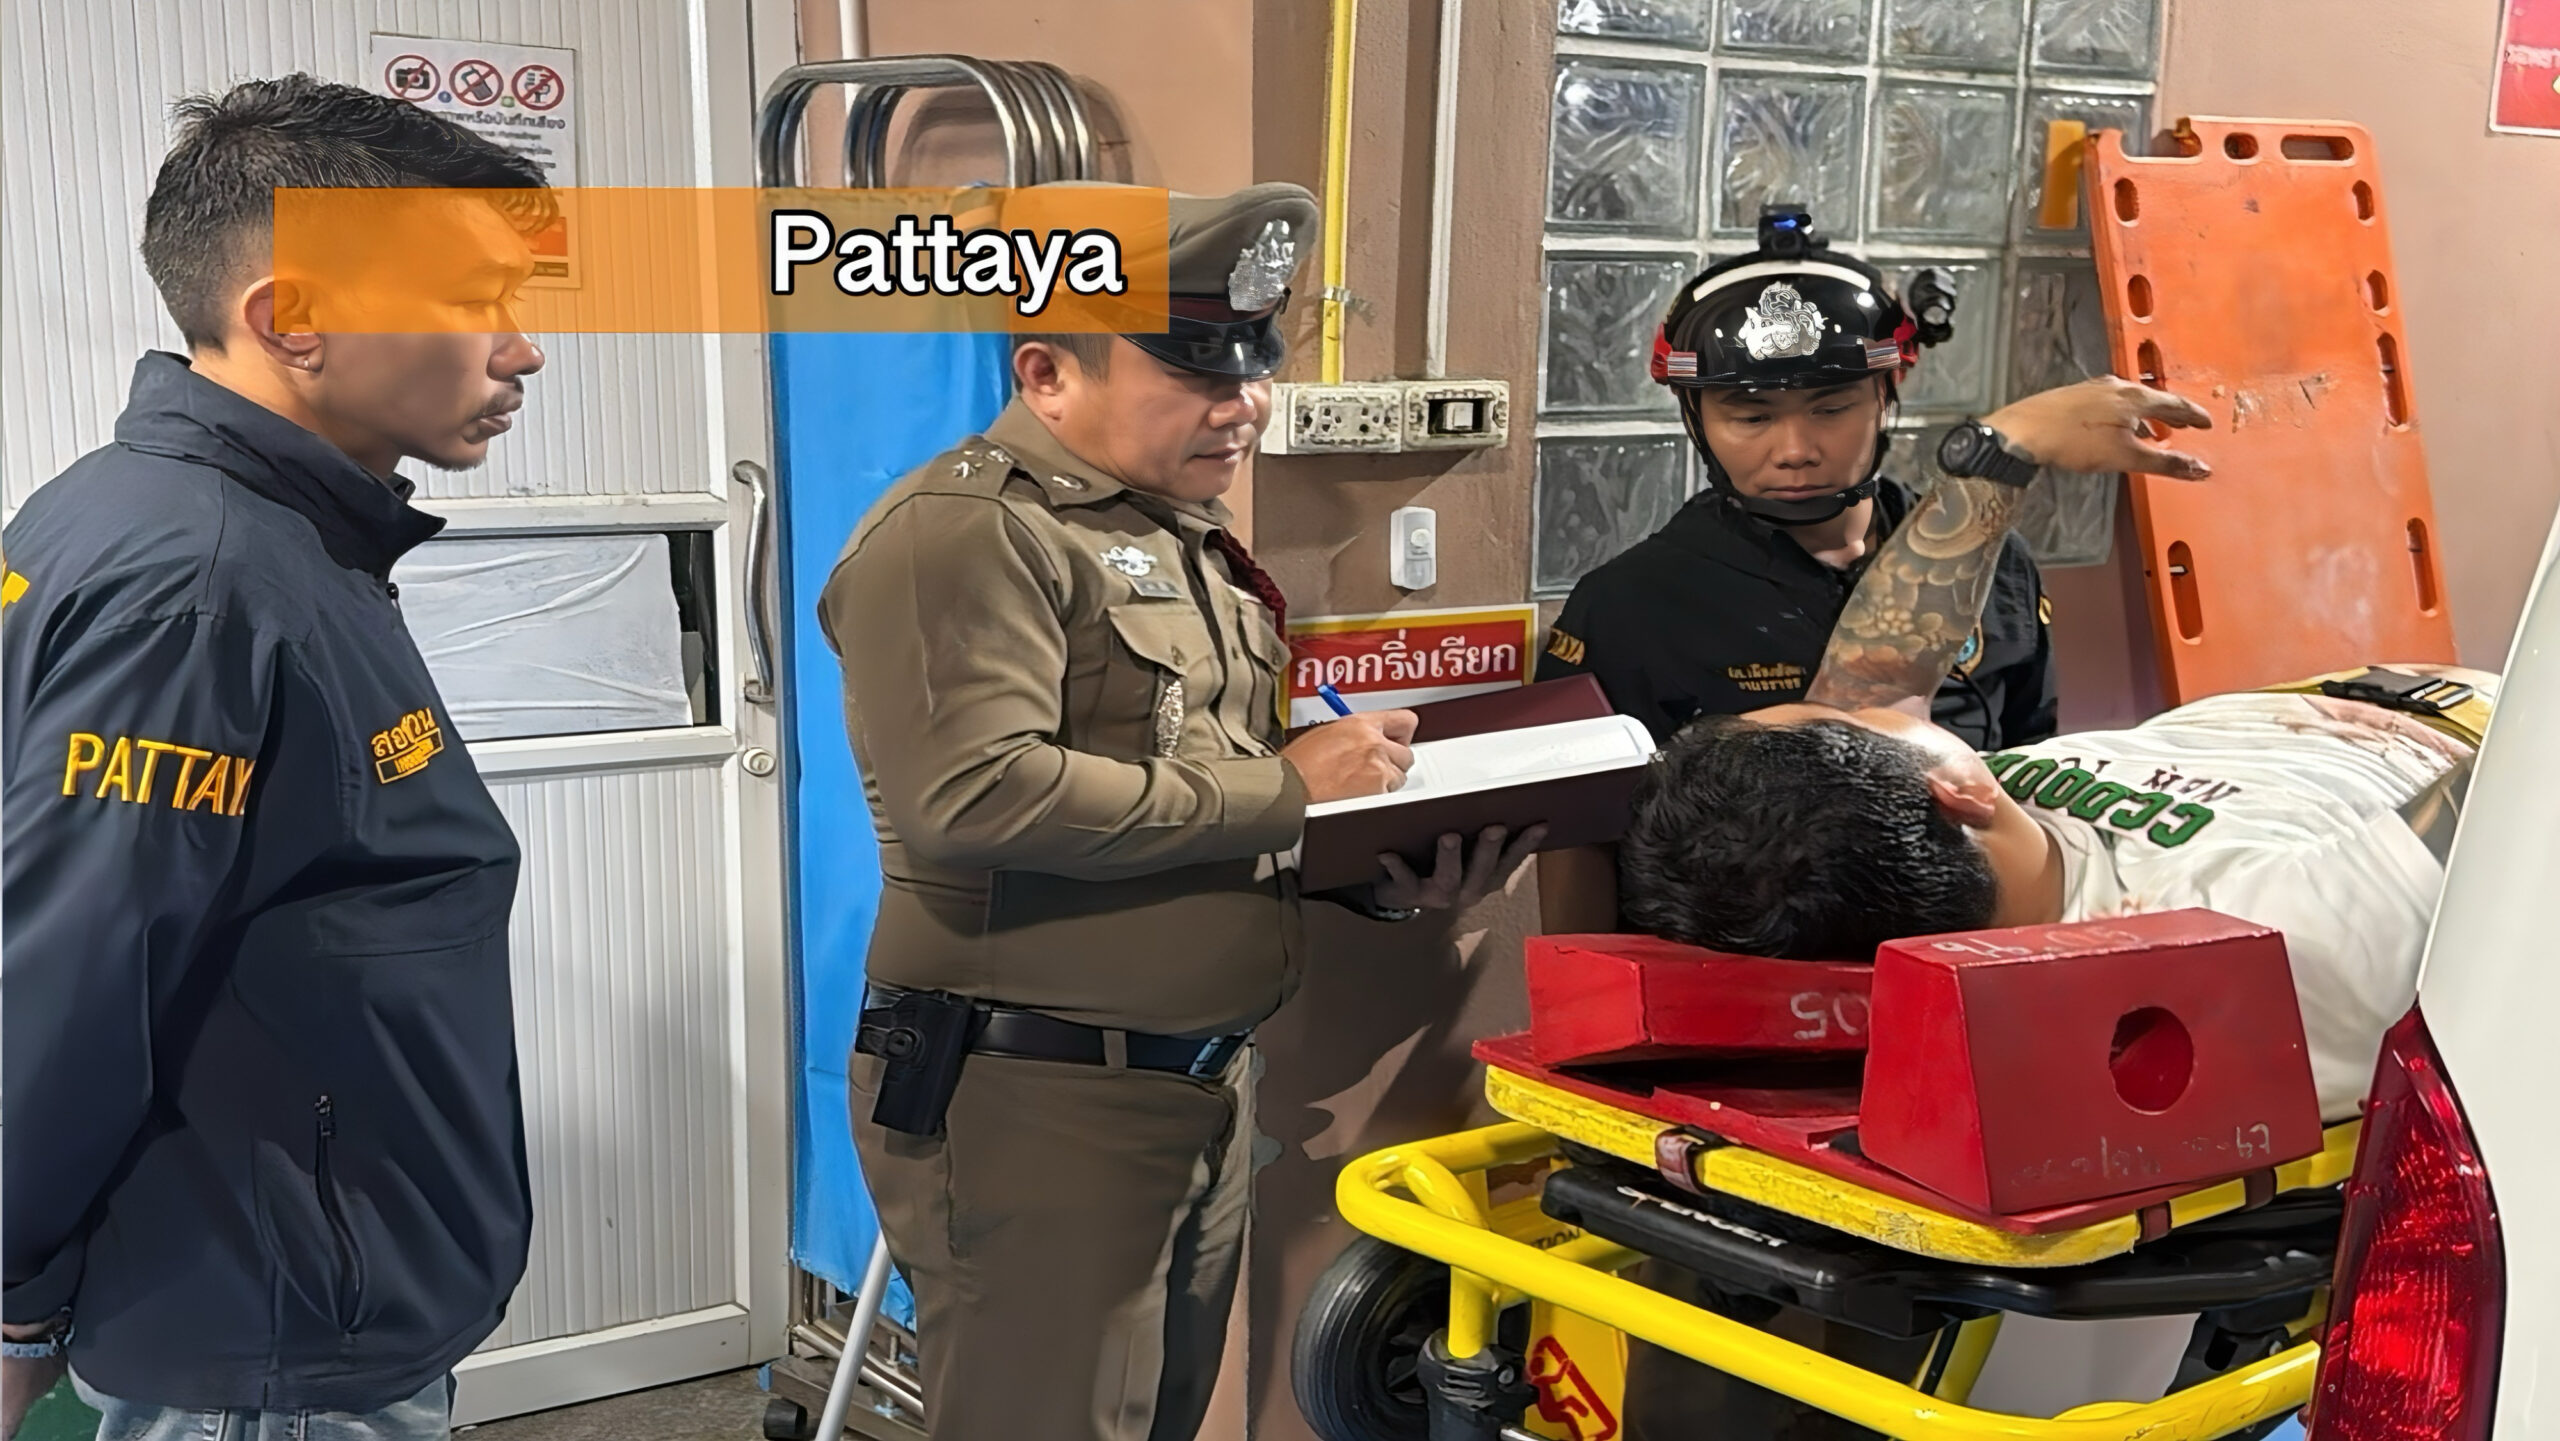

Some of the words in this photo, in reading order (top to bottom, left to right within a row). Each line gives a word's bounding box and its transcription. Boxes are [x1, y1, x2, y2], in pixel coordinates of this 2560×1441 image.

[1296, 628, 1517, 688] กดกริ่งเรียก
[62, 732, 256, 816] PATTAY
